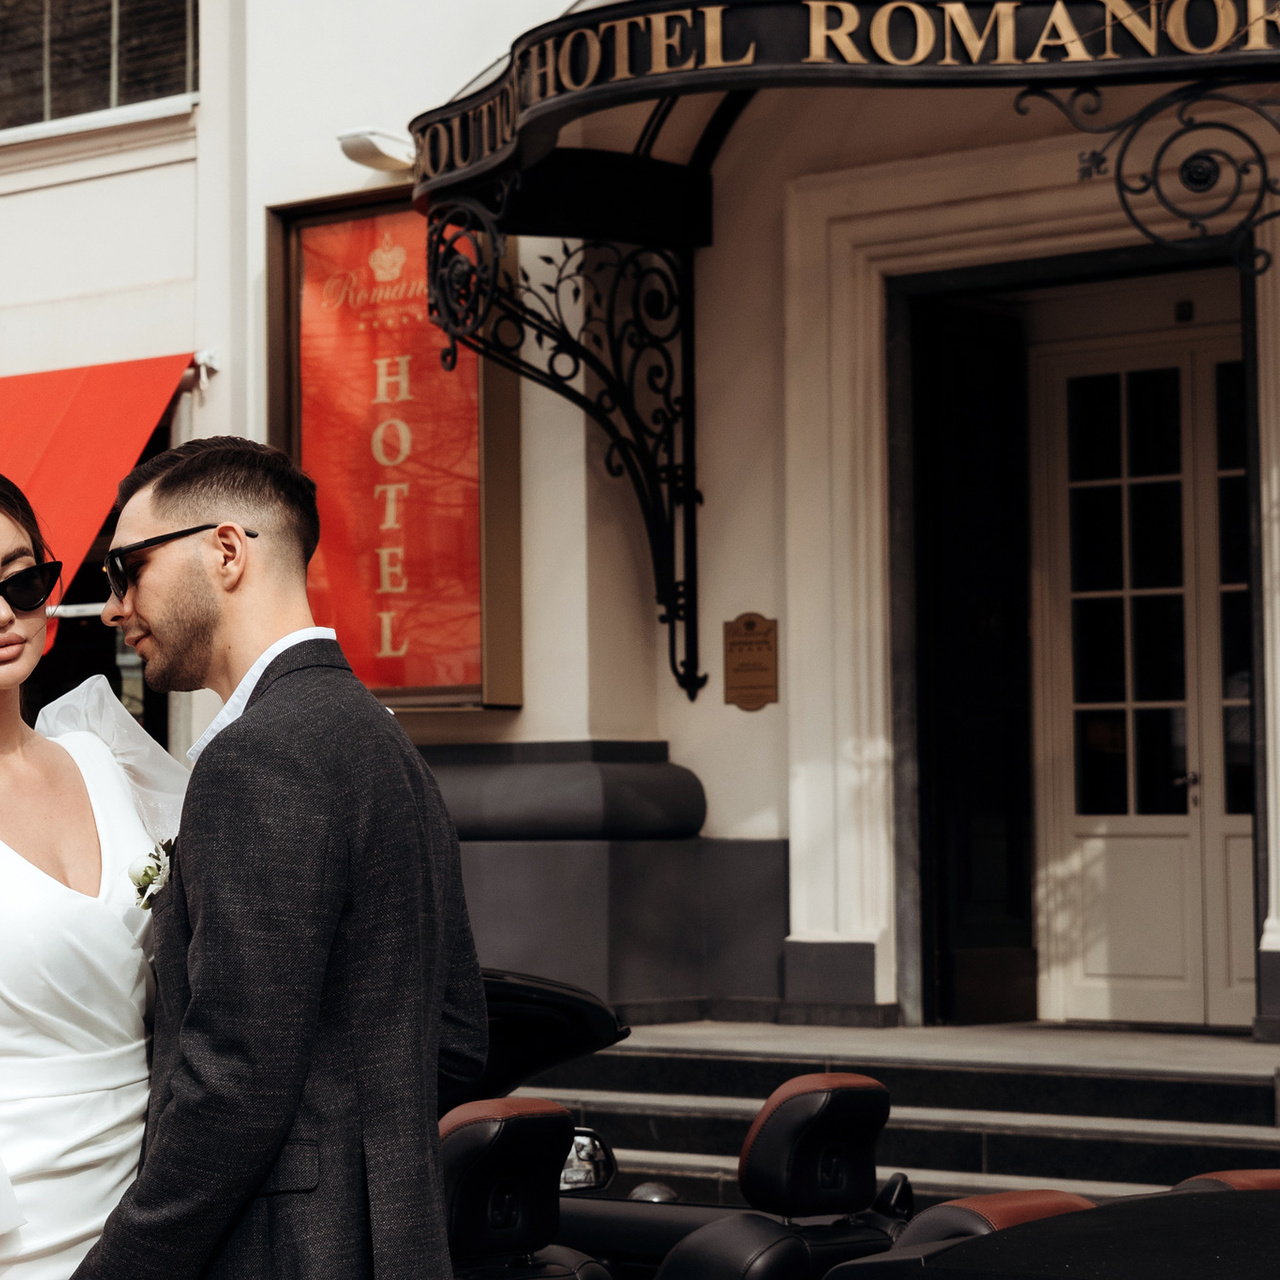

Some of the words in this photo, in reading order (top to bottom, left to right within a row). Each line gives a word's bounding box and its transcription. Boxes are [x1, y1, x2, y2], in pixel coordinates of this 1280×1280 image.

[527, 5, 756, 103] HOTEL
[322, 268, 428, 310] Roman
[371, 355, 413, 658] HOTEL
